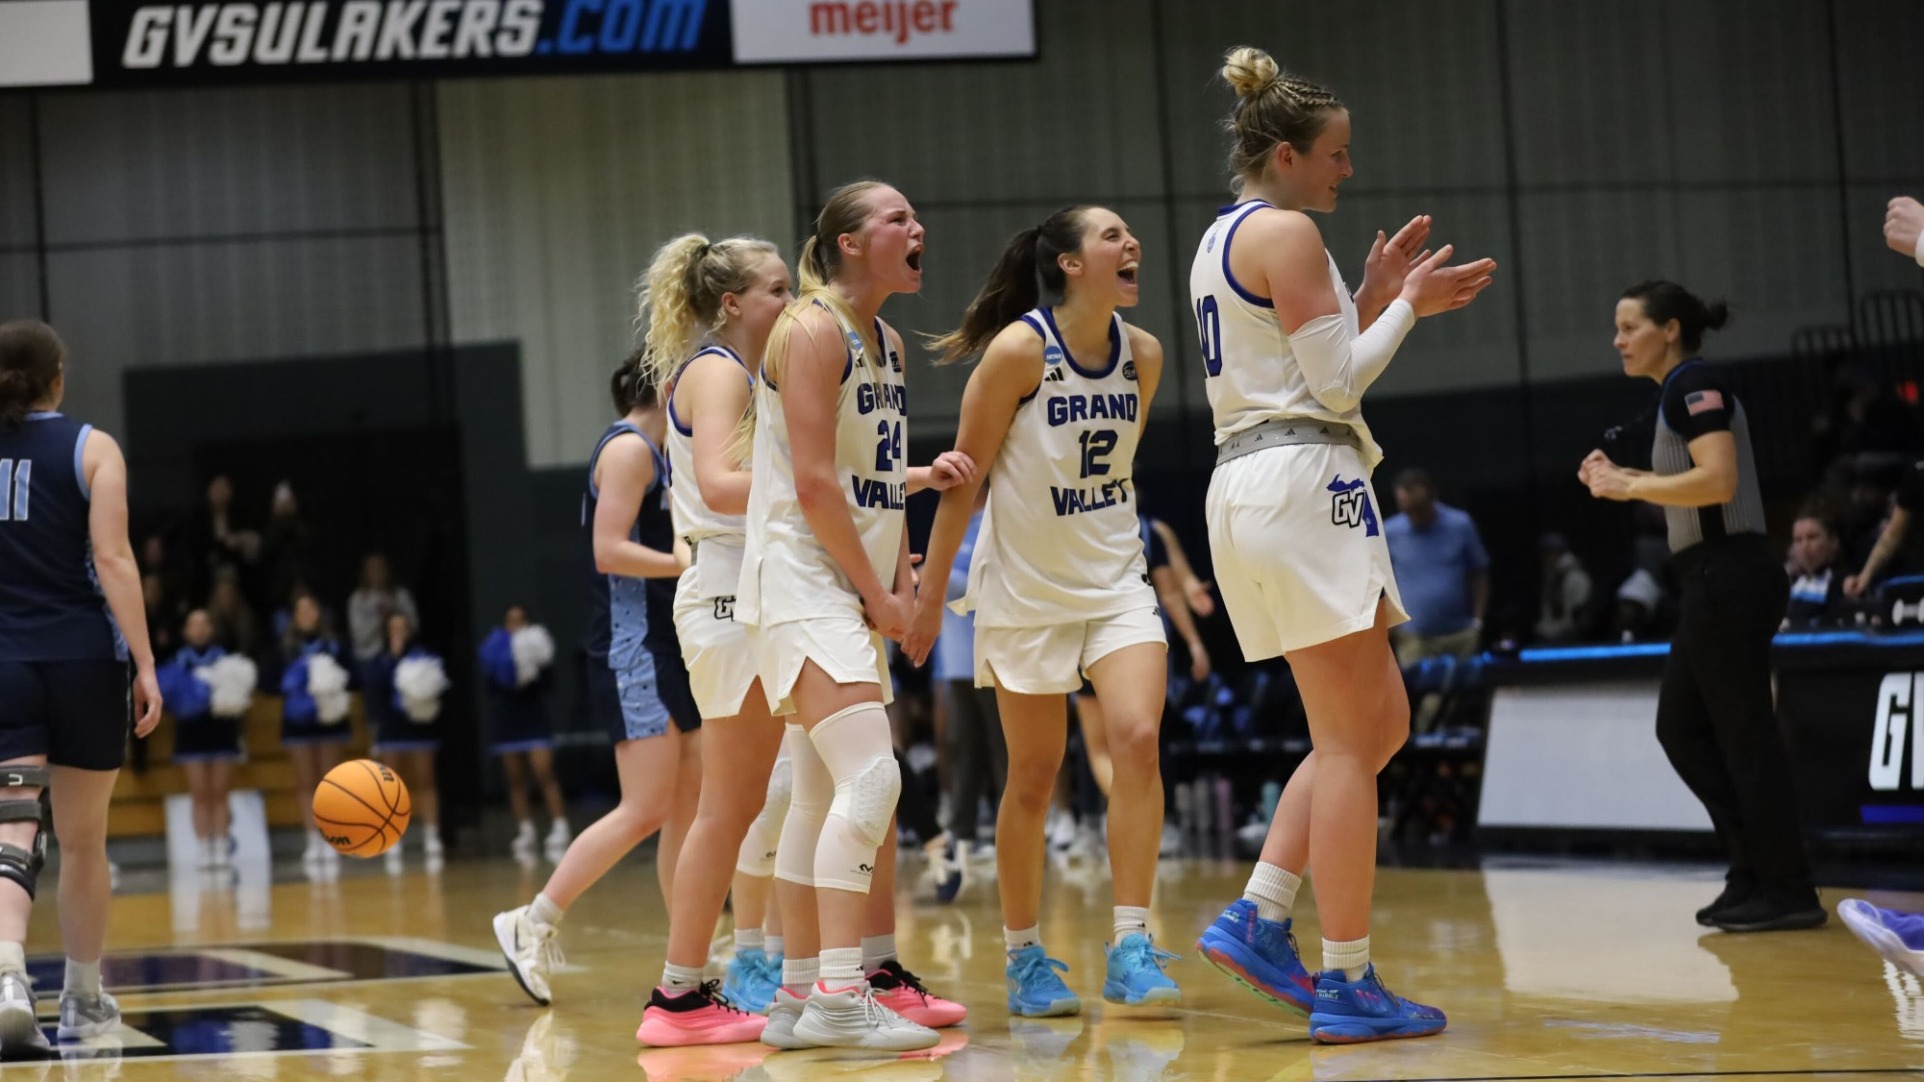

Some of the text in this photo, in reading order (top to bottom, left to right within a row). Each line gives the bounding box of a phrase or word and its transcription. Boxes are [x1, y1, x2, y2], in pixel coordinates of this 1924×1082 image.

[120, 0, 707, 69] GVSULAKERS.COM
[808, 0, 957, 46] meijer
[857, 382, 907, 416] GRAND
[1047, 393, 1138, 427] GRAND
[875, 419, 902, 473] 24
[1078, 429, 1118, 478] 12
[1049, 477, 1130, 516] VALLEY
[1331, 492, 1366, 528] GV
[714, 595, 736, 622] G
